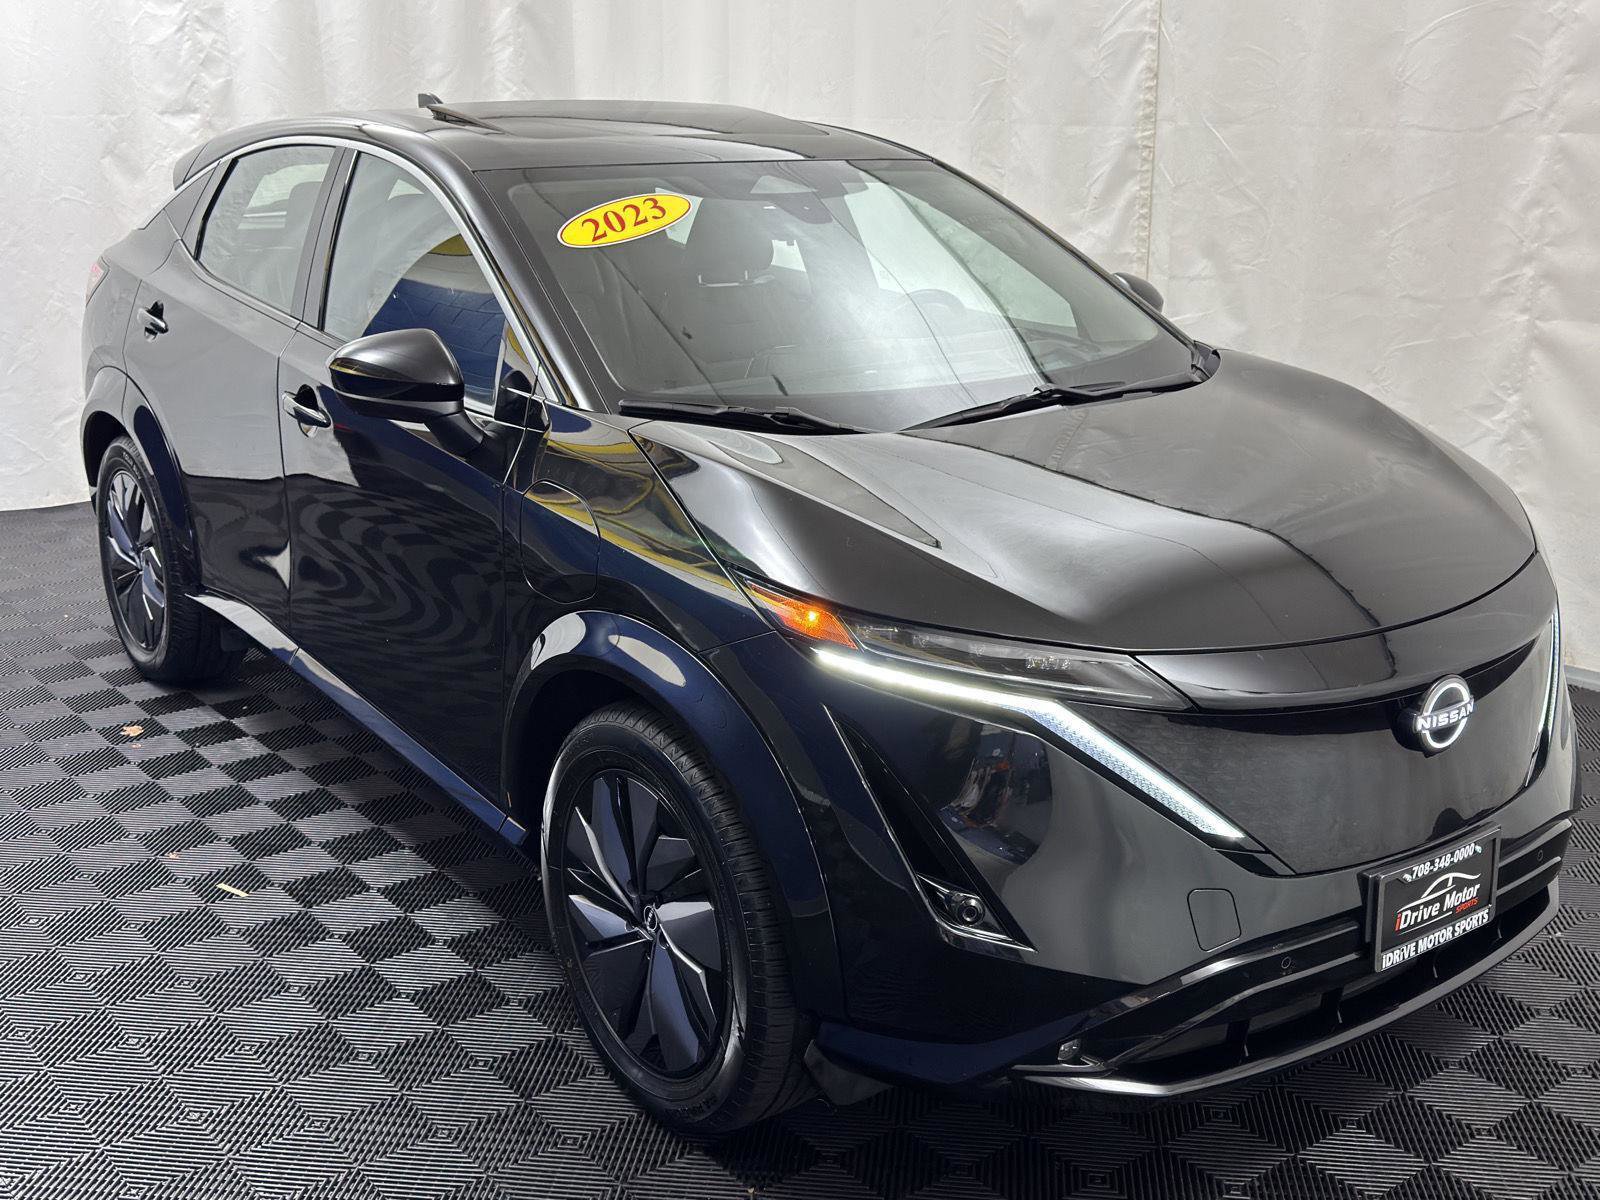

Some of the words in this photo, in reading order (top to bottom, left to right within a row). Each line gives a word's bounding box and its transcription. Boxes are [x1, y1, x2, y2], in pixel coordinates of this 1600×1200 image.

[581, 197, 667, 242] 2023
[1416, 697, 1474, 732] NISSAN
[1412, 842, 1475, 880] 708-348-0000
[1395, 902, 1440, 931] iDrive
[1443, 884, 1481, 911] Motor
[1455, 897, 1479, 914] SPORTS
[1417, 927, 1453, 954] MOTOR
[1454, 908, 1489, 936] SPORTS
